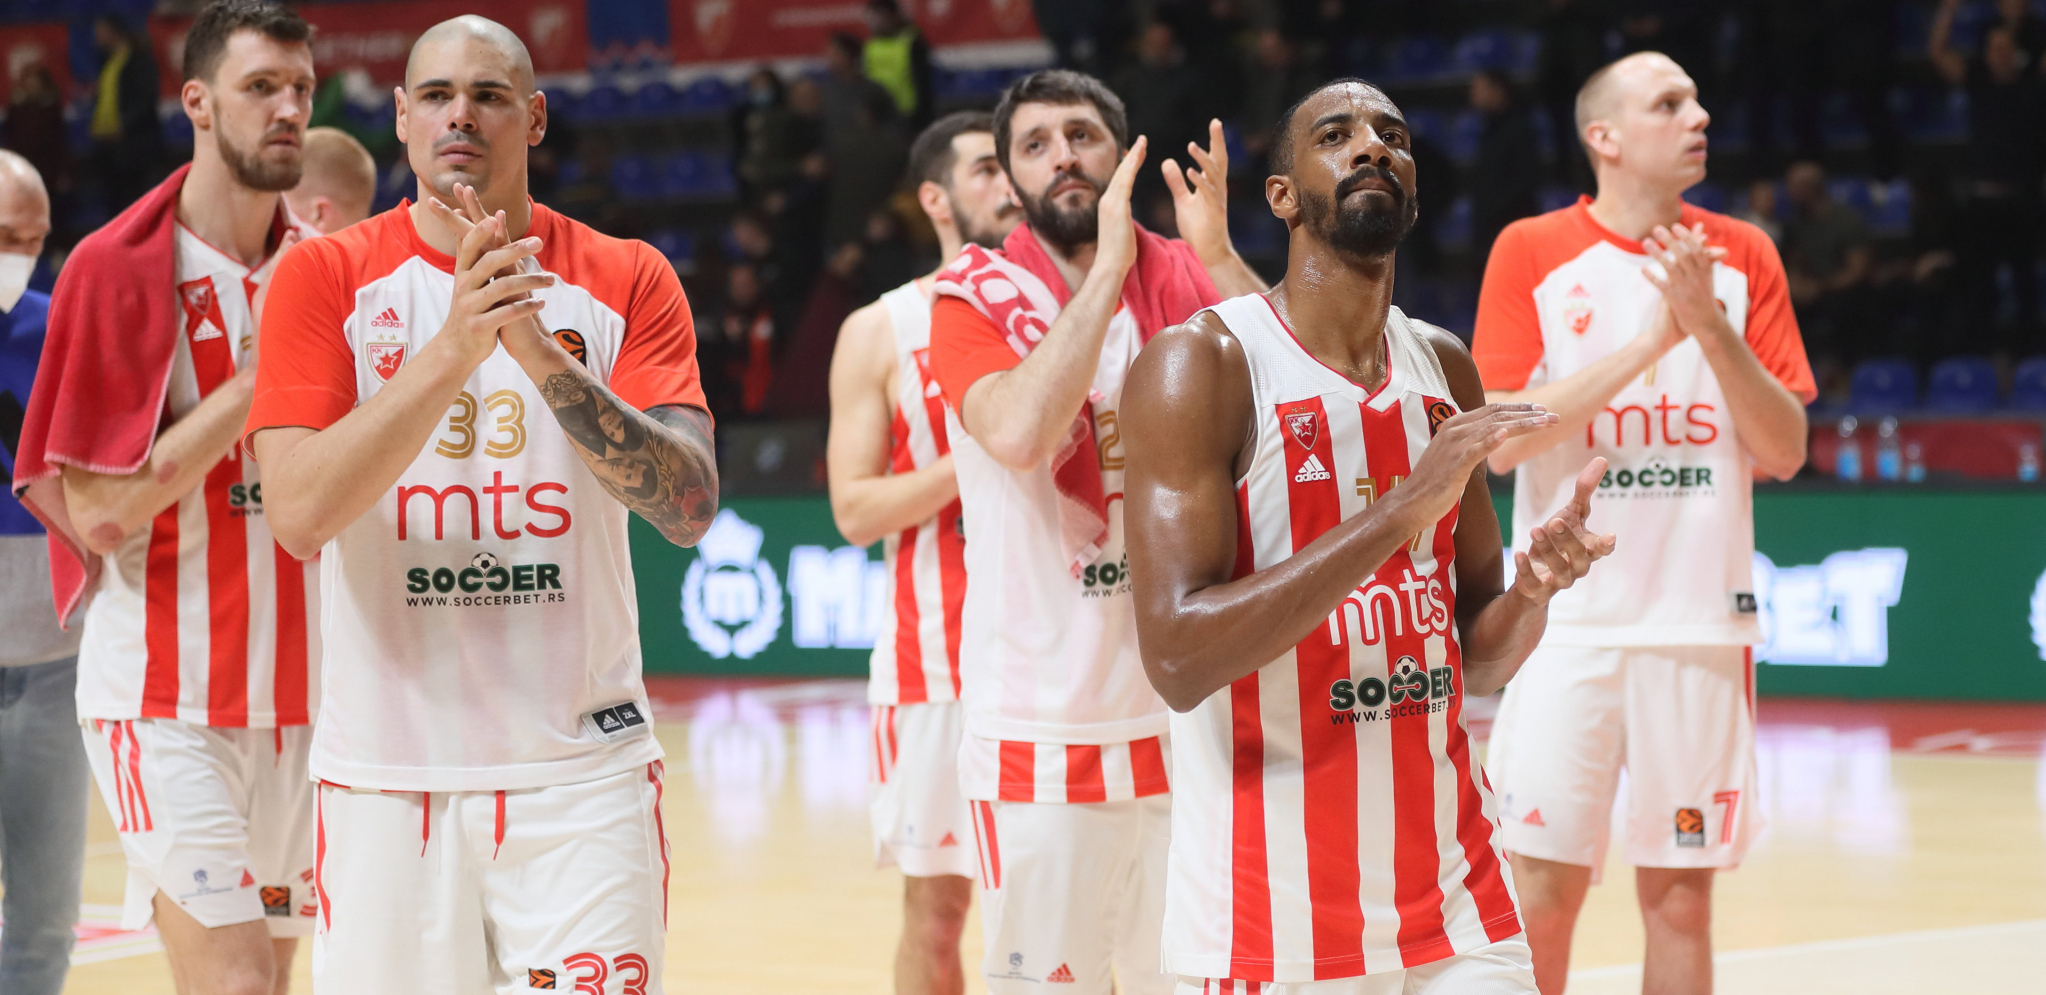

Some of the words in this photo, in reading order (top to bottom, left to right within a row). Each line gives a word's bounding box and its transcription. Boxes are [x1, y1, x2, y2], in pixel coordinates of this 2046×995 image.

[371, 319, 404, 328] adidas
[435, 389, 526, 459] 33
[1586, 394, 1718, 448] mts
[1294, 471, 1331, 483] adidas
[1599, 467, 1712, 488] SOCCER
[397, 471, 572, 541] mts
[406, 593, 566, 607] WWW.SOCCERBET.RS
[407, 563, 563, 594] SOCCER
[1328, 568, 1449, 646] mts
[1330, 665, 1456, 711] SOCCER
[1330, 698, 1457, 725] WWW.SOCCERBET.RS
[1713, 789, 1740, 845] 7
[562, 952, 649, 995] 33
